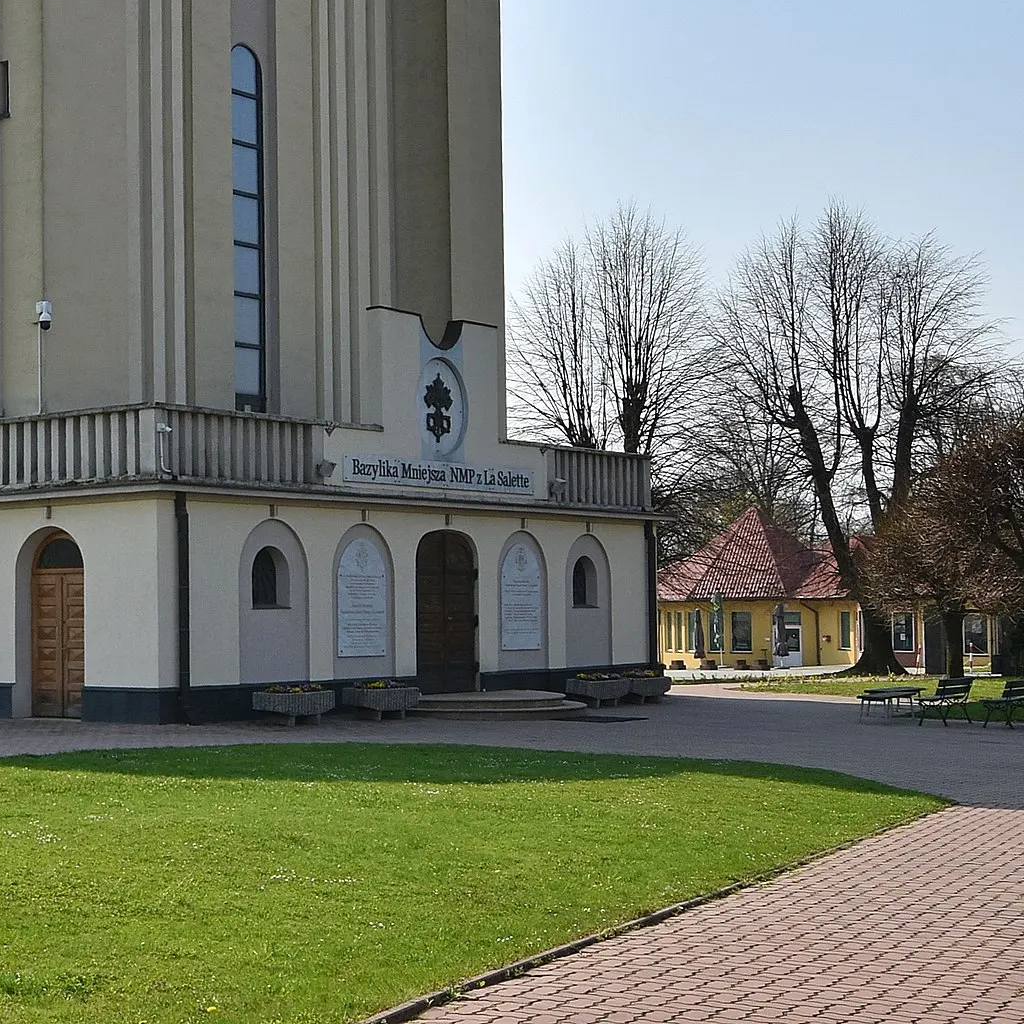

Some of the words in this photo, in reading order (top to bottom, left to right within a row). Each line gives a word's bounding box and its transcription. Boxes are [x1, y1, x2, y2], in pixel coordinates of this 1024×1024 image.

[352, 459, 399, 480] Bazylika
[401, 463, 446, 484] Mniejsza
[450, 467, 475, 484] NMP
[476, 473, 483, 485] z
[484, 470, 496, 486] La
[497, 470, 530, 488] Salette
